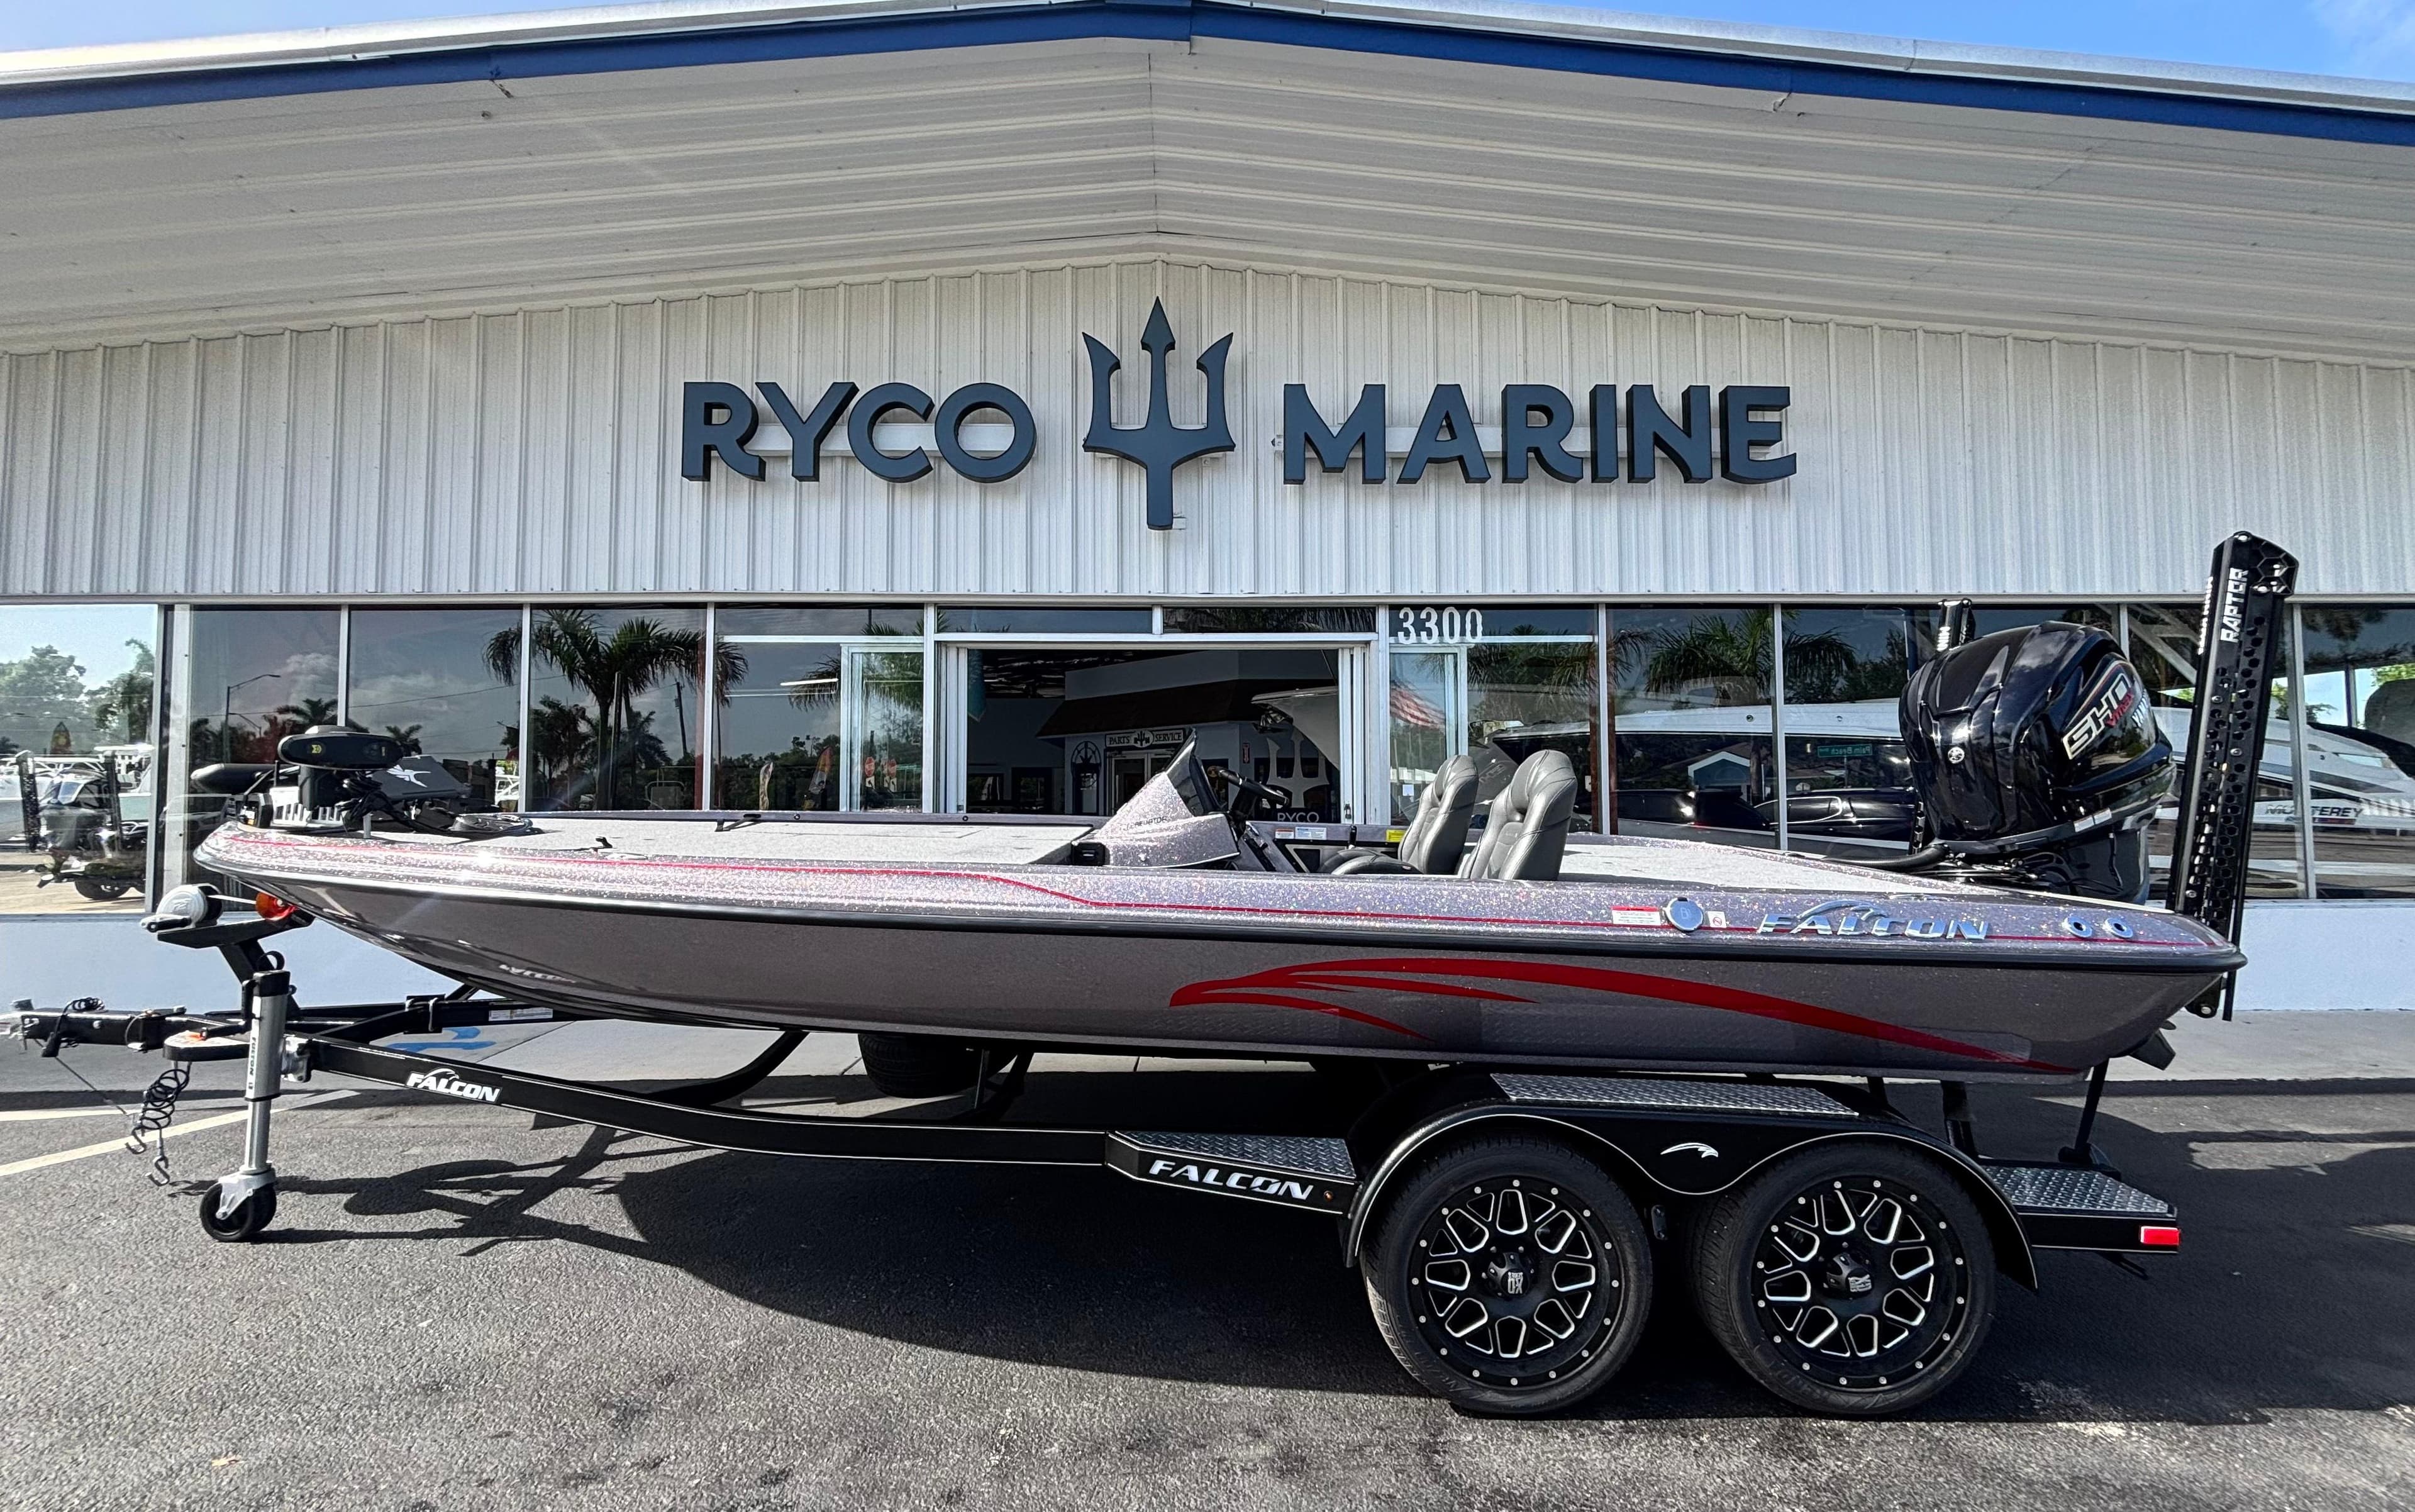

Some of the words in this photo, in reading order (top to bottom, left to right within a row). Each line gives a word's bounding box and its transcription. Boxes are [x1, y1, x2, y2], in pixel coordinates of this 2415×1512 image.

[682, 382, 1037, 483] RYCO
[1284, 383, 1797, 484] MARINE
[2220, 567, 2249, 643] RAPTOR
[1397, 606, 1483, 645] 3300
[2063, 672, 2131, 760] SHO
[1109, 736, 1130, 745] PARTS
[1155, 732, 1182, 742] SERVICE
[1277, 811, 1319, 823] RYCO
[1757, 913, 1989, 940] FALCON
[406, 1072, 501, 1103] FALCON
[1149, 1159, 1314, 1200] FALCON
